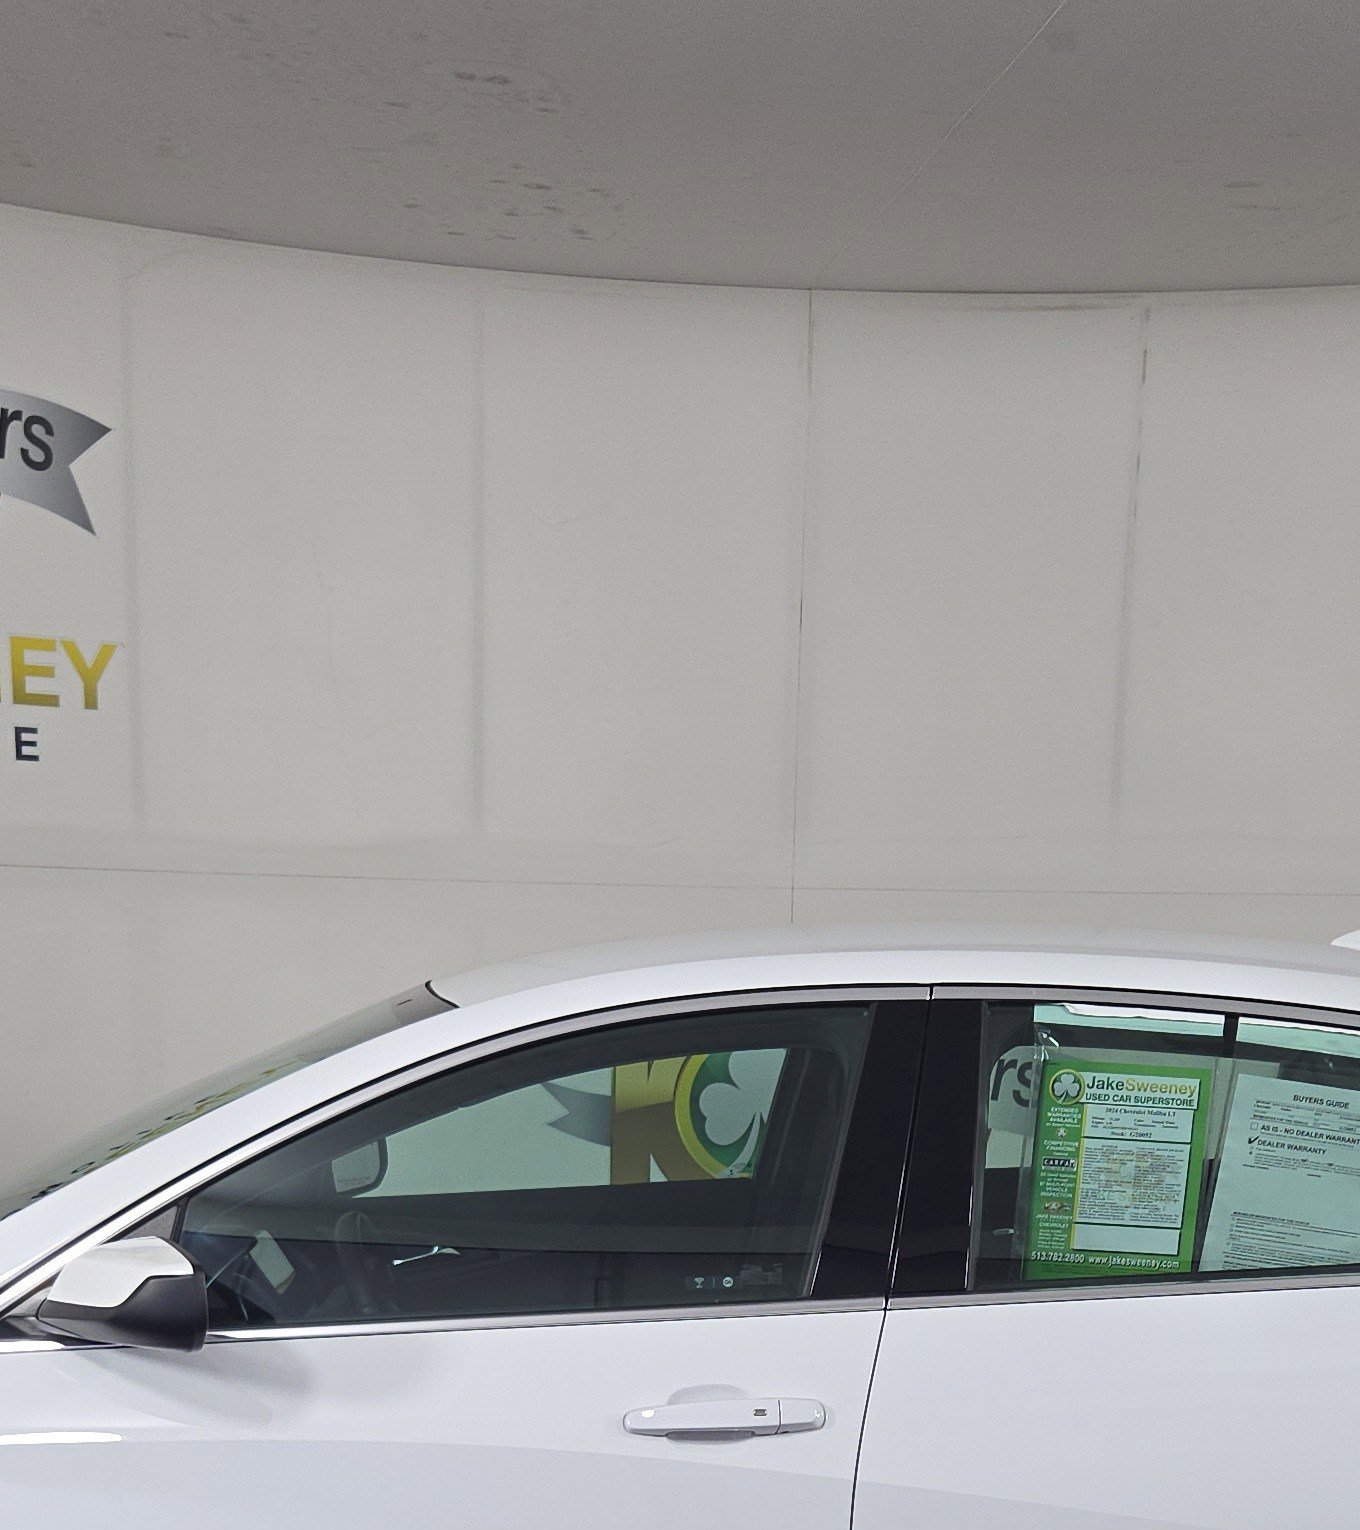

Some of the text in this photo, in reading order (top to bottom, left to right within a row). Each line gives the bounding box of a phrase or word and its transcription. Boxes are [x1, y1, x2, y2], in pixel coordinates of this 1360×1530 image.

[1085, 1093, 1195, 1107] USED CAR SUPERSTORE
[1293, 1094, 1350, 1109] BUYERS GUIDE
[1260, 1124, 1270, 1132] AS
[1284, 1127, 1295, 1135] NO
[1296, 1129, 1324, 1139] DEALER
[1257, 1139, 1285, 1149] DEALER
[1287, 1143, 1327, 1155] WARRANTY
